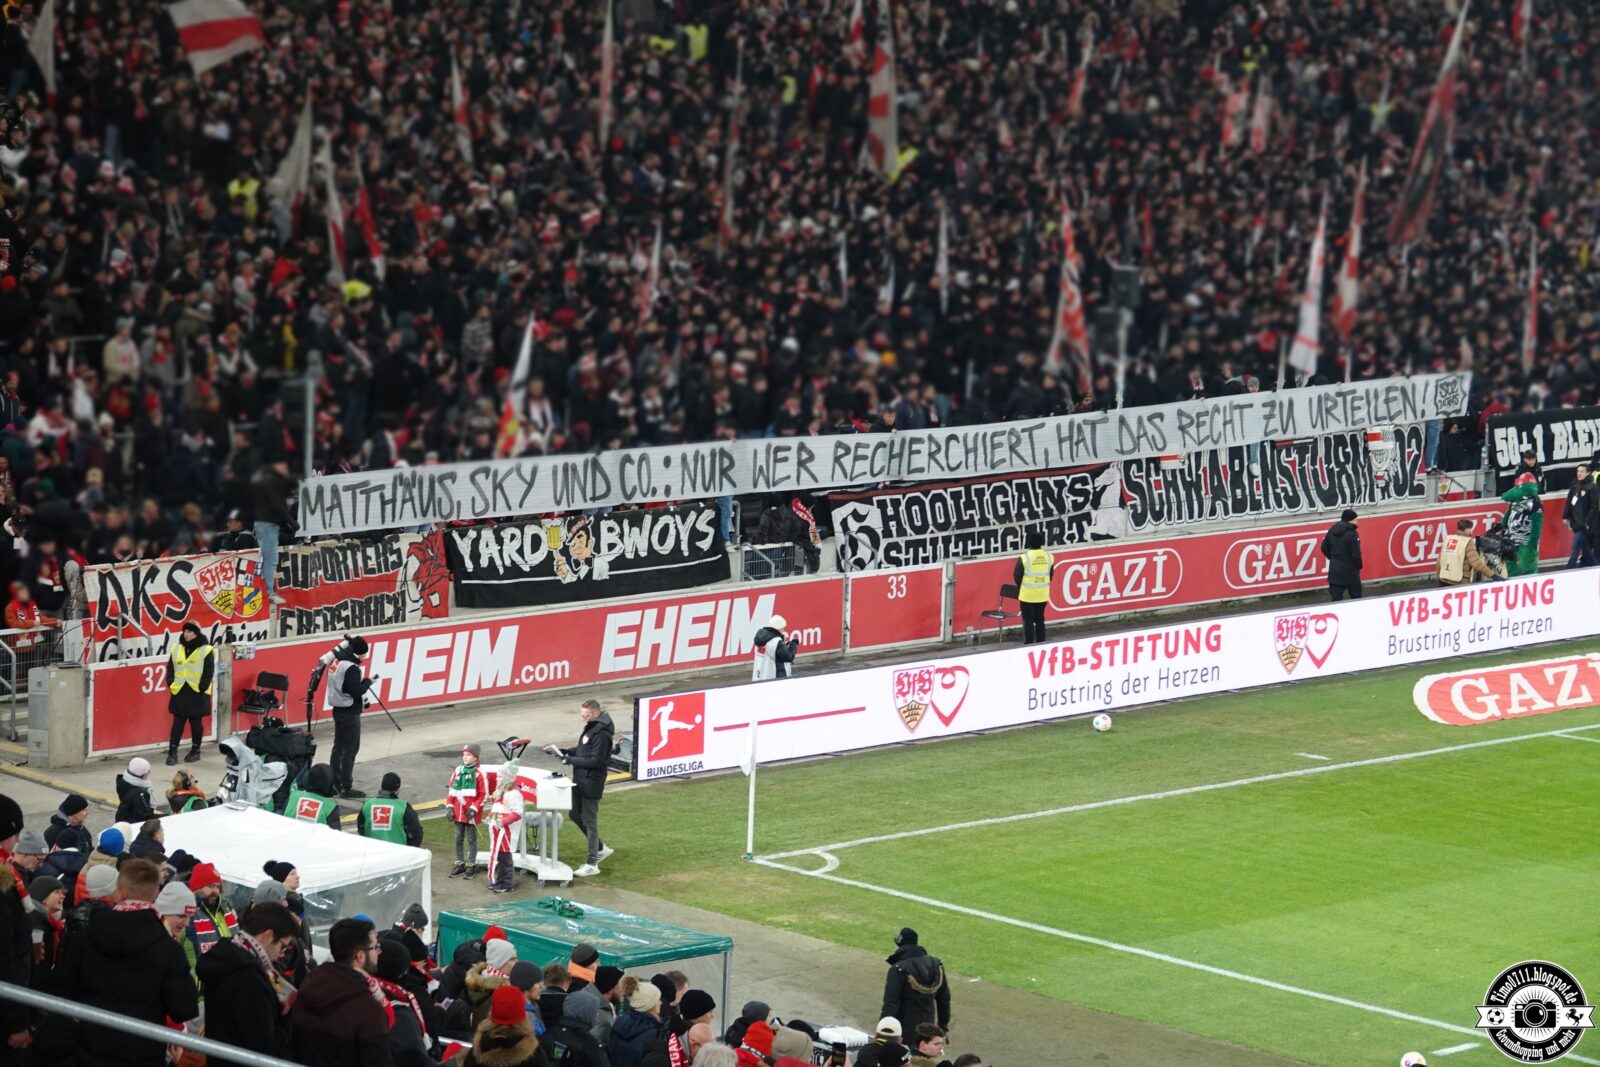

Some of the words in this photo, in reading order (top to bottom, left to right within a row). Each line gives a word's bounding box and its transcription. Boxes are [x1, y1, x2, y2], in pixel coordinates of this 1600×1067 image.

[302, 466, 462, 531] MATTHÄUS,
[470, 462, 539, 518] SKY
[551, 455, 612, 507] UND
[681, 448, 738, 495] NUR
[752, 443, 820, 491] WER
[831, 420, 1050, 482] RECHERCHIERT,
[1056, 416, 1109, 463] HAT
[1115, 411, 1168, 455] DAS
[1177, 402, 1254, 455] RECHT
[1262, 396, 1297, 438] ZU
[1309, 379, 1429, 430] URTEILEN!
[1391, 424, 1427, 499] 02
[1494, 425, 1546, 468] 50+1
[873, 474, 1091, 539] HOOLIGANS
[452, 523, 549, 575] YARD
[600, 509, 716, 562] BWOYS
[1239, 537, 1330, 584] GAZ
[887, 574, 907, 599] 33
[1389, 578, 1555, 627] VfB-STIFTUNG
[1027, 623, 1222, 680] VfB-STIFTUNG
[1389, 625, 1460, 656] Brustring
[1468, 621, 1492, 644] der
[1500, 616, 1553, 640] Herzen
[142, 666, 167, 693] 32
[1028, 678, 1112, 711] Brustring
[1120, 671, 1149, 696] der
[1158, 663, 1220, 690] Herzen
[647, 761, 704, 777] BUNDESLIGA
